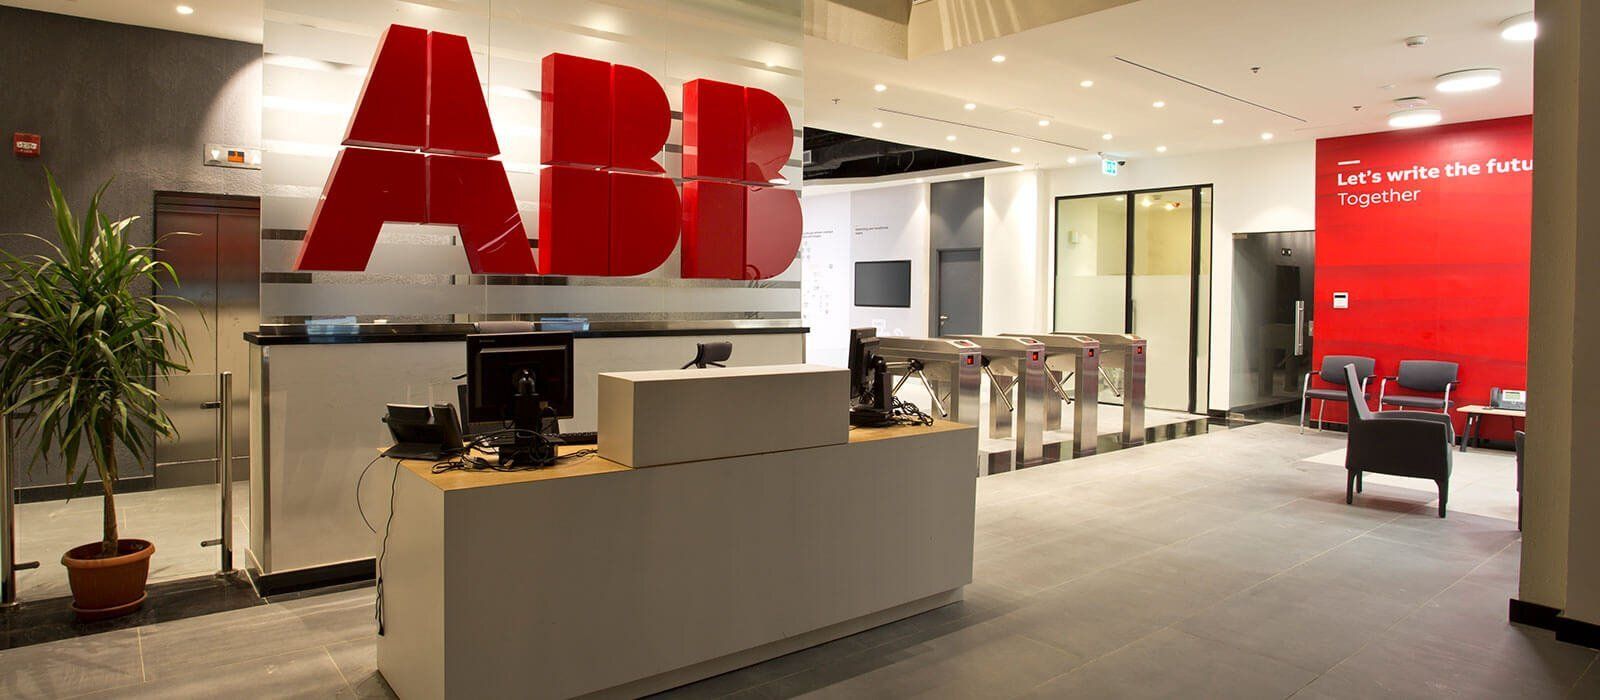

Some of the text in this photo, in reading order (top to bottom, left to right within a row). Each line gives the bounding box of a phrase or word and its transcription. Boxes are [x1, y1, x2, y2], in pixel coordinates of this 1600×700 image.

[293, 24, 803, 280] ABB
[1337, 169, 1382, 186] Let’s
[1387, 165, 1440, 182] write
[1444, 161, 1481, 177] the
[1337, 188, 1421, 208] Together
